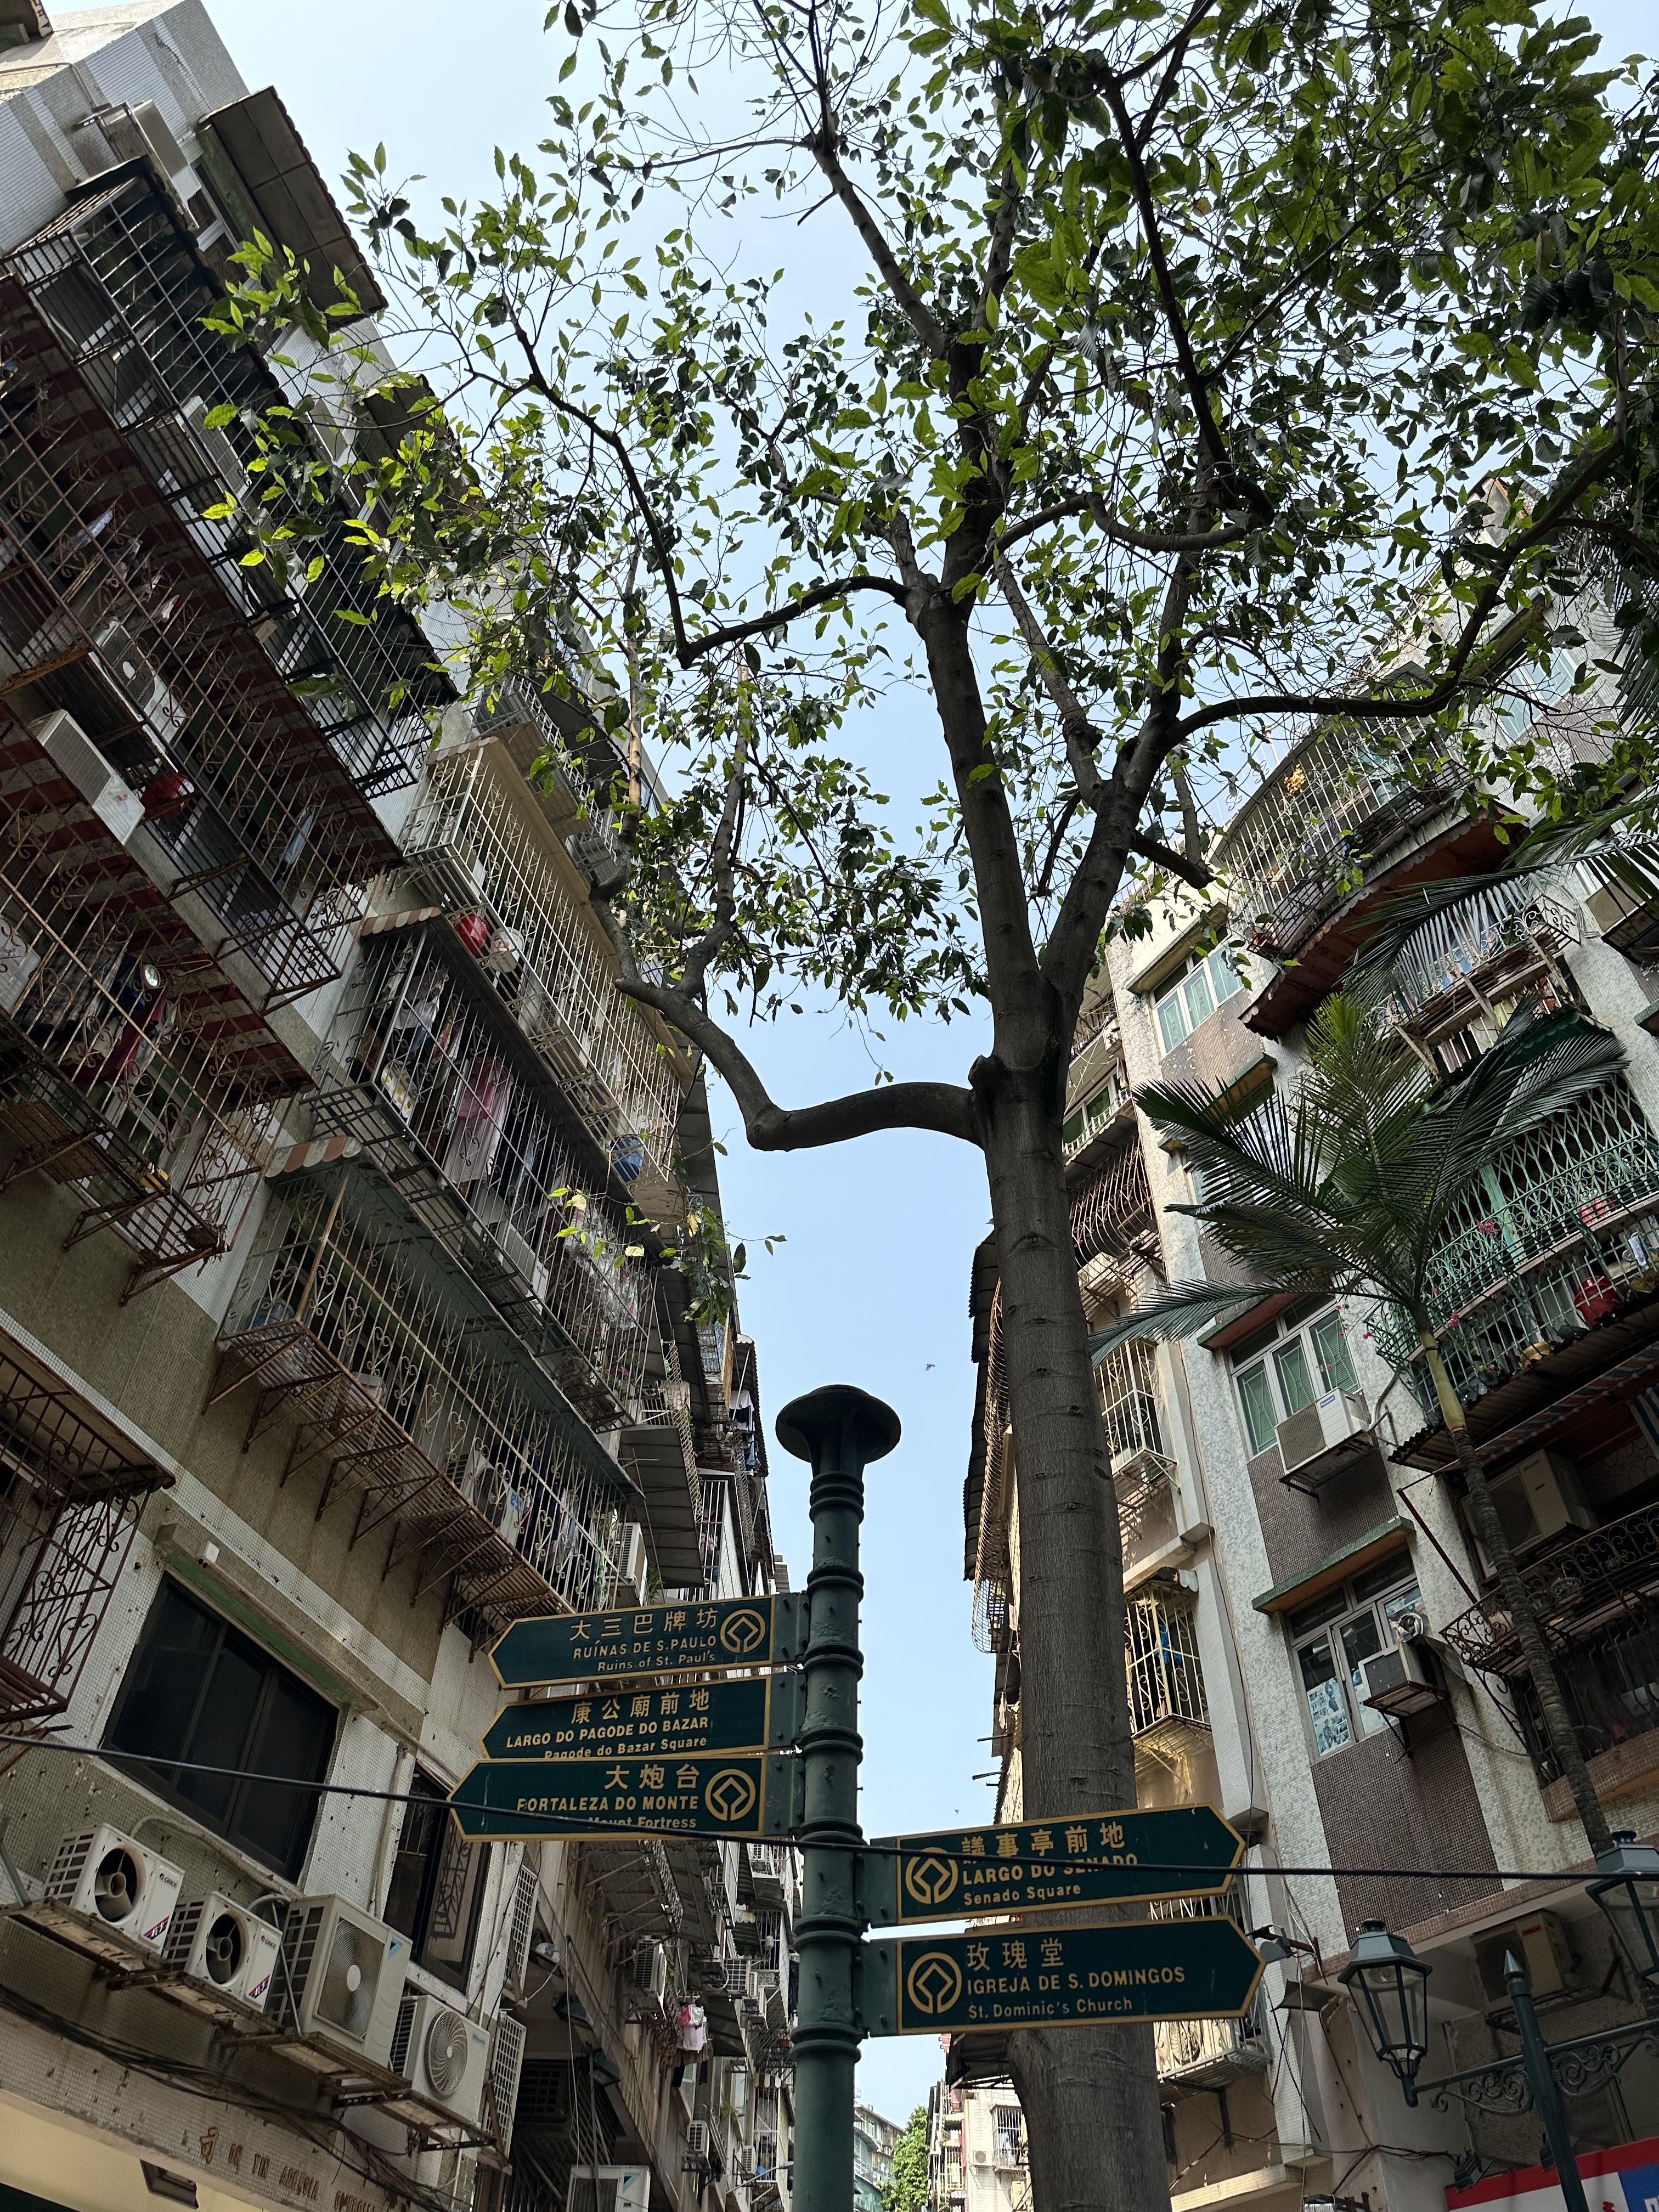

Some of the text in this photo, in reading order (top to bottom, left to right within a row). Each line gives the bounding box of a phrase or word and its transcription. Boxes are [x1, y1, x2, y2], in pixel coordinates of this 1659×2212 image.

[569, 1607, 719, 1641] 大三巴牌坊
[573, 1635, 716, 1660] RUÍNAS DE S.PAULO
[597, 1650, 715, 1672] Ruins of St. Paul's
[571, 1688, 710, 1724] 康公廟前地
[506, 1717, 709, 1748] LARGO DO PAGODE DO BAZAR
[544, 1737, 707, 1759] Pagode do Bazar Square
[604, 1763, 700, 1790] 大炮台
[516, 1795, 698, 1812] FORTALEZA DO MONTE
[637, 1816, 697, 1829] Fortress
[961, 1821, 1125, 1865] 議事亭前地
[963, 1864, 1023, 1886] LARGO
[1031, 1862, 1056, 1878] DO
[964, 1884, 1082, 1906] Senado Square
[966, 1937, 1064, 1972] 玫瑰堂
[967, 1966, 1186, 1995] IGREJA DE S. DOMINGOS
[968, 1996, 1132, 2020] St. Dominic's Church
